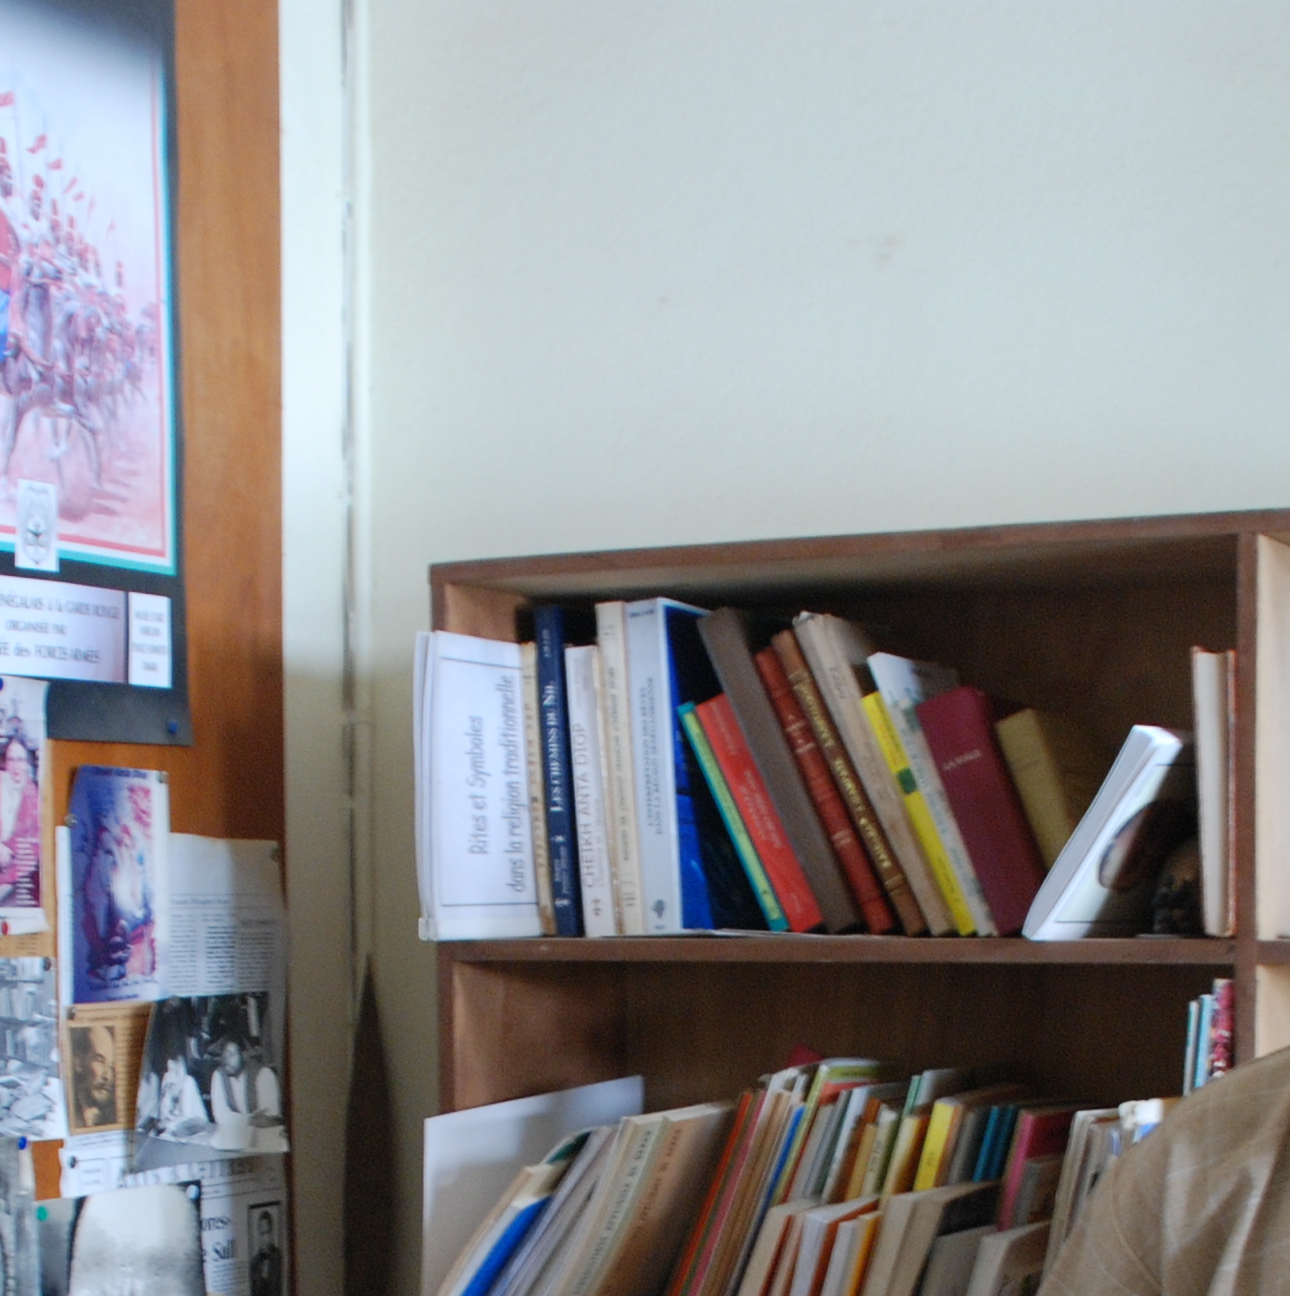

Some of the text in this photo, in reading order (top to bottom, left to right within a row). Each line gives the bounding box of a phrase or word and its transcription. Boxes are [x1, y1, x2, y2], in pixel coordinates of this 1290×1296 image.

[466, 714, 492, 854] Rites et Symboles
[497, 673, 525, 892] dans la religion traditionnelle
[571, 722, 599, 889] CHEIKH ANTA DIOP
